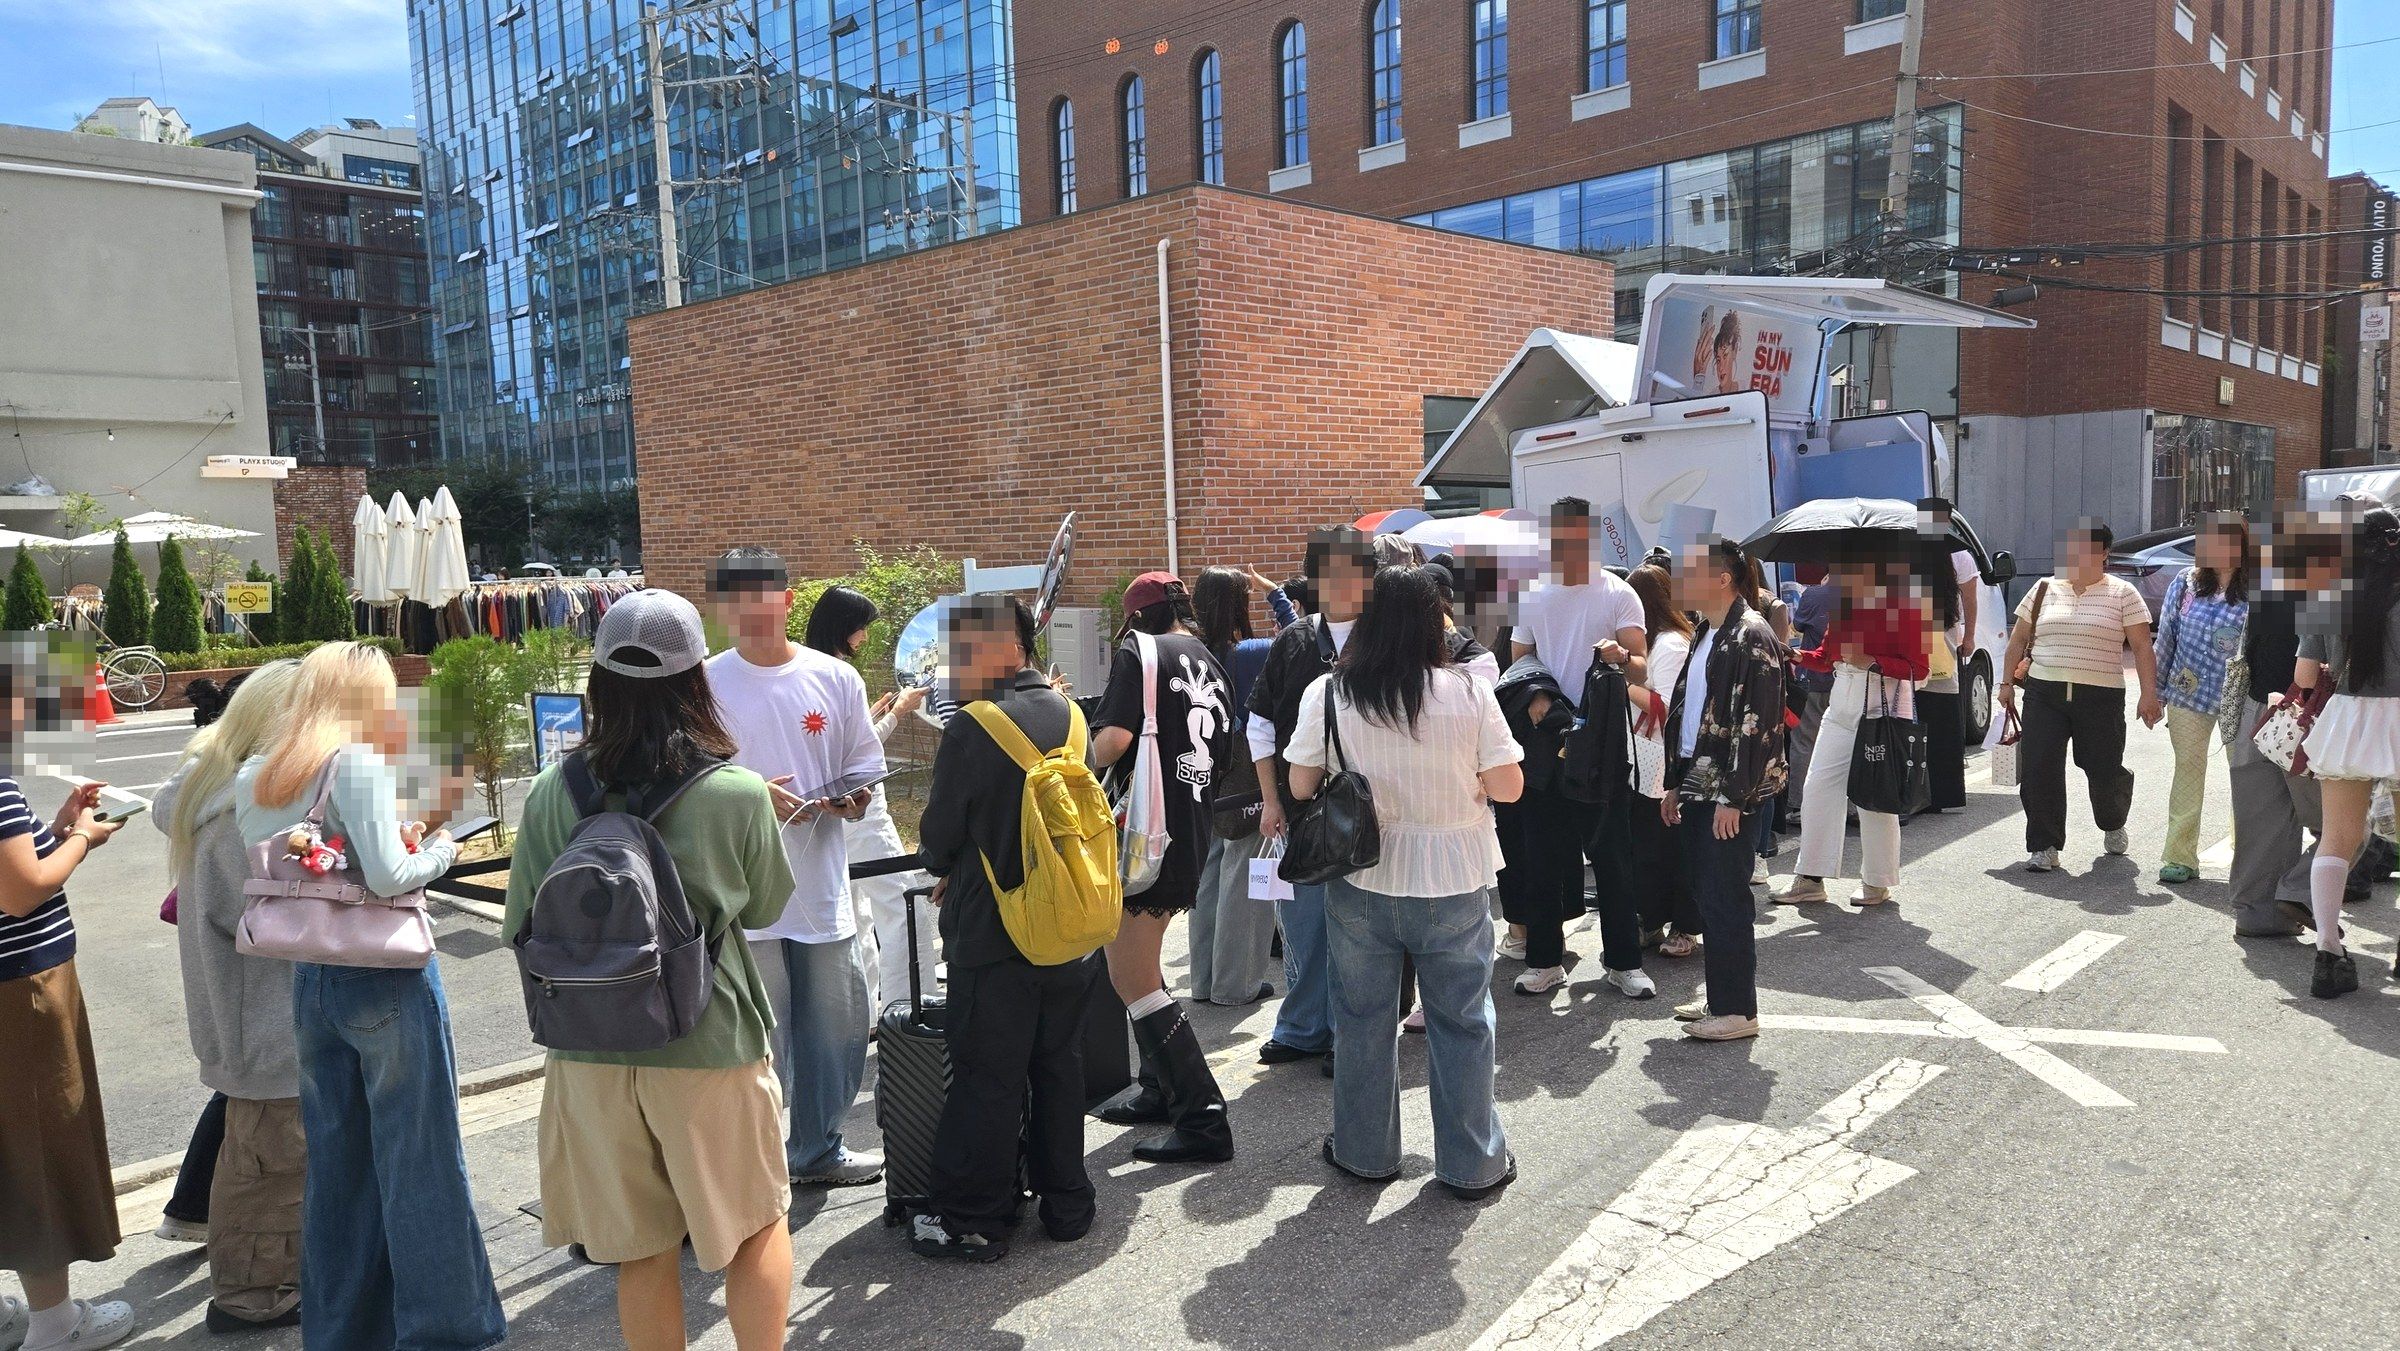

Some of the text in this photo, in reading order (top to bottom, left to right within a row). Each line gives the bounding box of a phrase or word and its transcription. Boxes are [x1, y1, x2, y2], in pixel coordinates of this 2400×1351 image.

[2371, 200, 2386, 279] OLIV YOUNG
[1757, 330, 1782, 346] IN MY
[1753, 345, 1793, 374] SUN
[1750, 373, 1782, 397] ERA
[239, 457, 261, 465] PLAYX
[1603, 516, 1628, 561] TOCOBO
